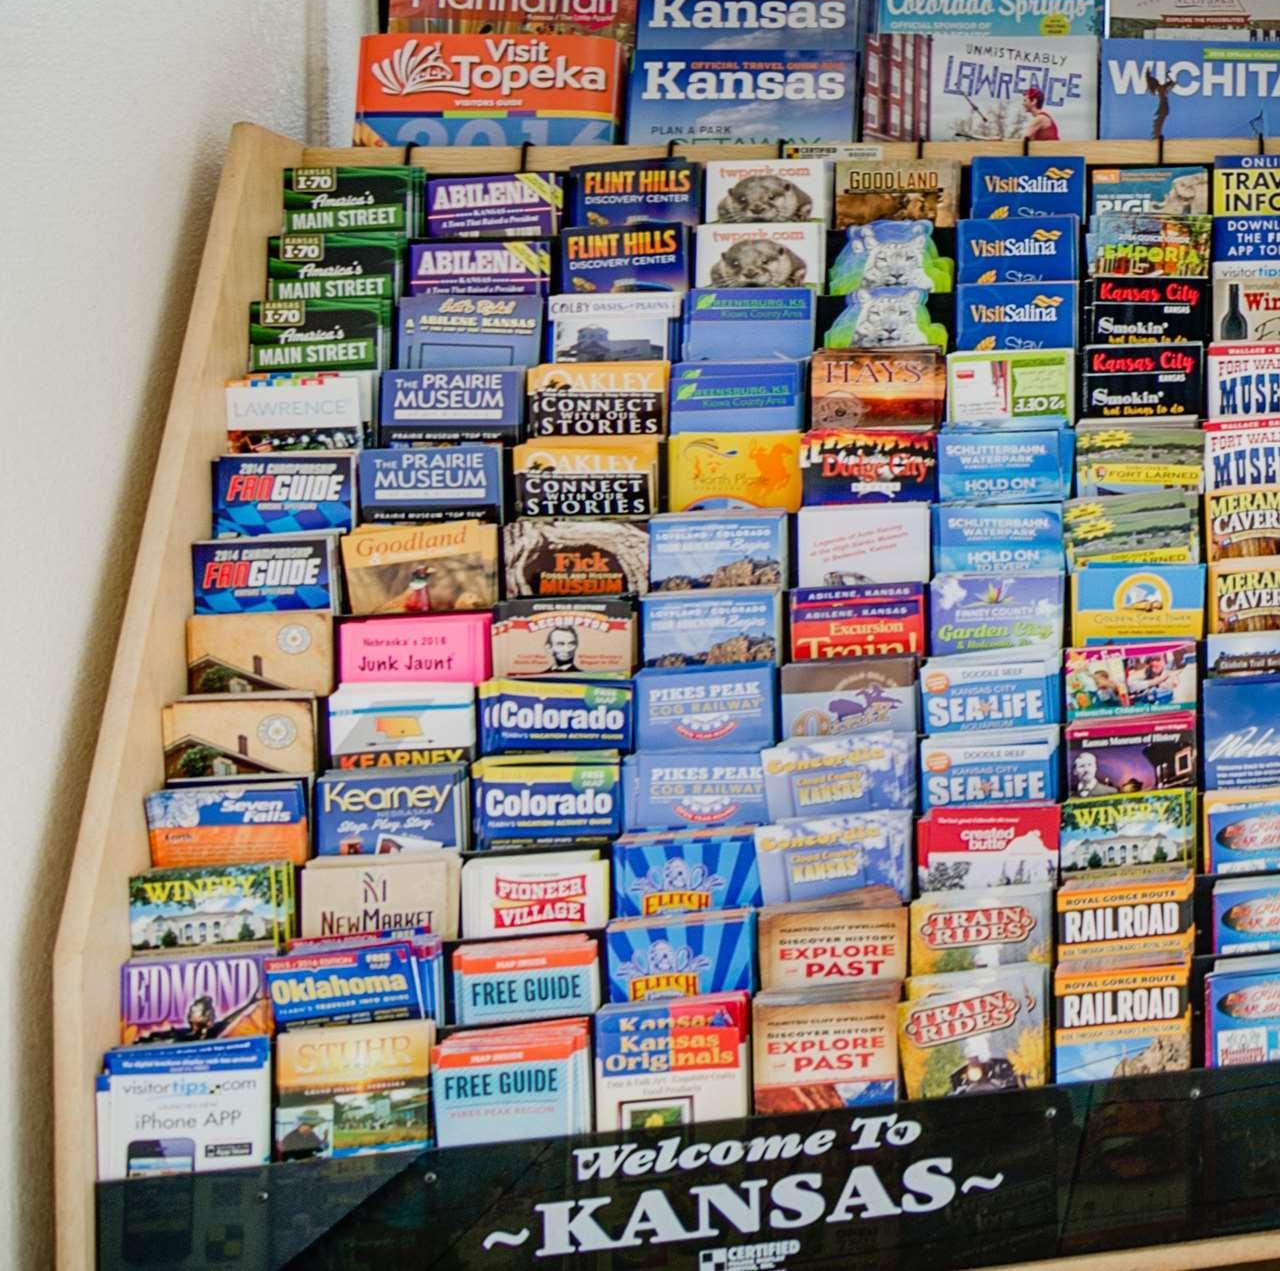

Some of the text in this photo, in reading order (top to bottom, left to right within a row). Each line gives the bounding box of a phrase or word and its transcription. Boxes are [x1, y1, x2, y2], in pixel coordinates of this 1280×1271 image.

[485, 39, 550, 63] Visit
[966, 44, 1068, 67] UNMISTAKABLY
[450, 55, 607, 96] Topeka
[641, 61, 846, 100] Kansas
[944, 55, 1083, 108] LAWRENCE
[584, 168, 691, 194] FLINT HILLS
[984, 174, 1069, 194] VisitSalina
[310, 190, 375, 209] America's
[433, 180, 540, 211] ABILENE
[585, 193, 689, 206] DISCOVERY CENTER
[292, 207, 397, 231] MAIN STREET
[567, 230, 677, 261] FLINT HILLS
[970, 237, 1056, 258] VisitSalina
[1237, 232, 1263, 243] THE
[1103, 244, 1200, 266] EMPORIA
[1227, 244, 1254, 256] APP
[298, 261, 363, 279] America's
[417, 248, 527, 276] ABILENE
[569, 254, 676, 270] DISCOVERY CENTER
[278, 277, 385, 300] MAIN STREET
[1099, 283, 1201, 307] Kansas City
[969, 302, 1057, 323] VisitSalina
[277, 326, 345, 344] America's
[1097, 316, 1169, 335] Smokin'
[259, 341, 368, 367] MAIN STREET
[1092, 352, 1195, 377] Kansas City
[824, 360, 922, 384] HAYS
[1217, 361, 1249, 377] FORT
[422, 374, 503, 389] PRAIRIE
[393, 389, 505, 409] MUSEUM
[541, 396, 657, 414] CONNECT
[1091, 388, 1164, 407] Smokin'
[232, 399, 346, 418] LAWRENCE
[541, 417, 658, 435] STORIES
[1210, 434, 1243, 449] FORT
[402, 453, 484, 469] PRAIRIE
[821, 452, 928, 482] Dodge City
[374, 470, 487, 489] MUSEUM
[965, 477, 1036, 491] HOLD ON
[1107, 469, 1199, 480] FORT LARNED
[525, 478, 643, 494] CONNECT
[526, 498, 646, 516] STORIES
[356, 526, 467, 557] Goodland
[716, 527, 772, 537] COLORADO
[967, 549, 1040, 564] HOLD ON
[540, 578, 622, 595] MUSEUM
[808, 587, 911, 601] ABILENE, KANSAS
[710, 604, 768, 615] COLORADO
[805, 606, 908, 621] ABILENE, KANSAS
[829, 620, 904, 635] Excursion
[938, 622, 1055, 642] Garden City
[358, 654, 454, 672] Junk Jaunt
[648, 680, 761, 703] PIKES PEAK
[500, 700, 625, 730] Colorado
[649, 697, 762, 716] COG RAILWAY
[927, 695, 982, 728] SEA
[340, 749, 463, 770] KEARNEY
[651, 765, 764, 782] PIKES PEAK
[324, 782, 452, 814] Kearney
[650, 781, 764, 796] COG RAILWAY
[928, 776, 982, 806] SEA
[220, 798, 293, 824] Seven Falls
[485, 788, 613, 818] Colorado
[1072, 802, 1170, 828] WINERY
[142, 875, 258, 903] WINERY
[496, 876, 584, 900] PIONEER
[1065, 890, 1177, 907] ROYAL GORGE ROUTE
[645, 892, 710, 915] ELITCH
[499, 904, 581, 926] VILLAGE
[930, 908, 1022, 929] TRAIN
[1064, 902, 1180, 943] RAILROAD
[844, 934, 896, 944] HISTORY
[935, 923, 1020, 944] RIDES
[779, 944, 896, 962] EXPLORE
[805, 960, 886, 978] PAST
[271, 973, 408, 1006] Oklahoma
[472, 974, 582, 1007] FREE GUIDE
[631, 973, 698, 1000] ELITCH
[1064, 974, 1176, 991] ROYAL GORGE ROUTE
[914, 992, 1005, 1028] TRAIN
[1063, 986, 1180, 1028] RAILROAD
[832, 1027, 885, 1037] HISTORY
[918, 1010, 1013, 1044] RIDES
[620, 1032, 720, 1053] Kansas
[767, 1036, 886, 1056] EXPLORE
[606, 1046, 735, 1072] Originals
[793, 1053, 875, 1073] PAST
[444, 1067, 559, 1101] FREE GUIDE
[135, 1109, 242, 1131] iPhone APP
[572, 1113, 923, 1182] Welcome To
[727, 1239, 800, 1261] CERTIFIED
